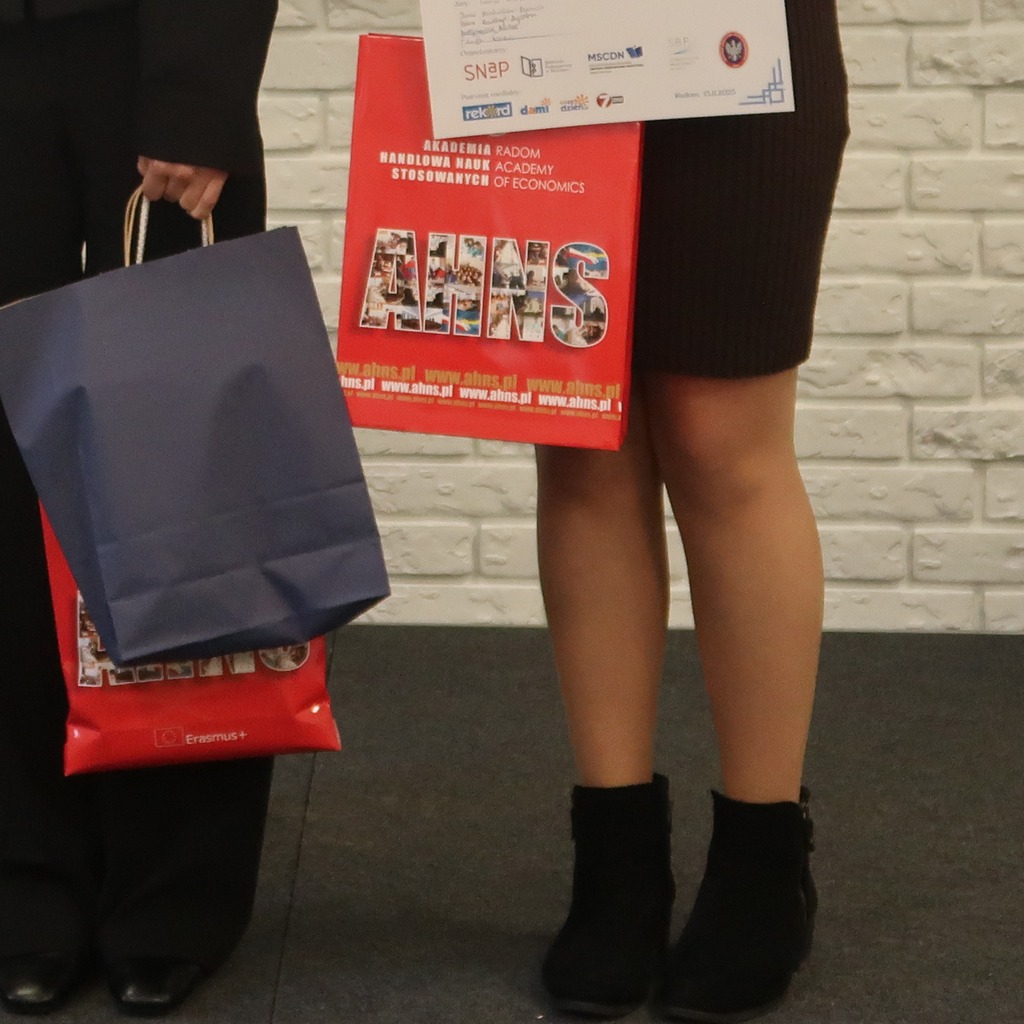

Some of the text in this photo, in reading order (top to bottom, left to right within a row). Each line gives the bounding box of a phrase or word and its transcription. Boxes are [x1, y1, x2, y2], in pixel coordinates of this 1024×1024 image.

[588, 51, 624, 61] MSCDN
[423, 140, 491, 156] AKADEMIA
[495, 145, 541, 159] RADOM
[380, 151, 490, 171] HANDLOWA NAUK
[495, 162, 554, 175] ACADEMY
[392, 168, 489, 186] STOSOWANYCH
[494, 176, 585, 194] OF ECONOMICS
[359, 228, 610, 348] AHNS
[382, 380, 453, 398] www.ahns.pl
[460, 387, 532, 406] www.ahns.pl
[539, 394, 612, 413] www.ahns.pl
